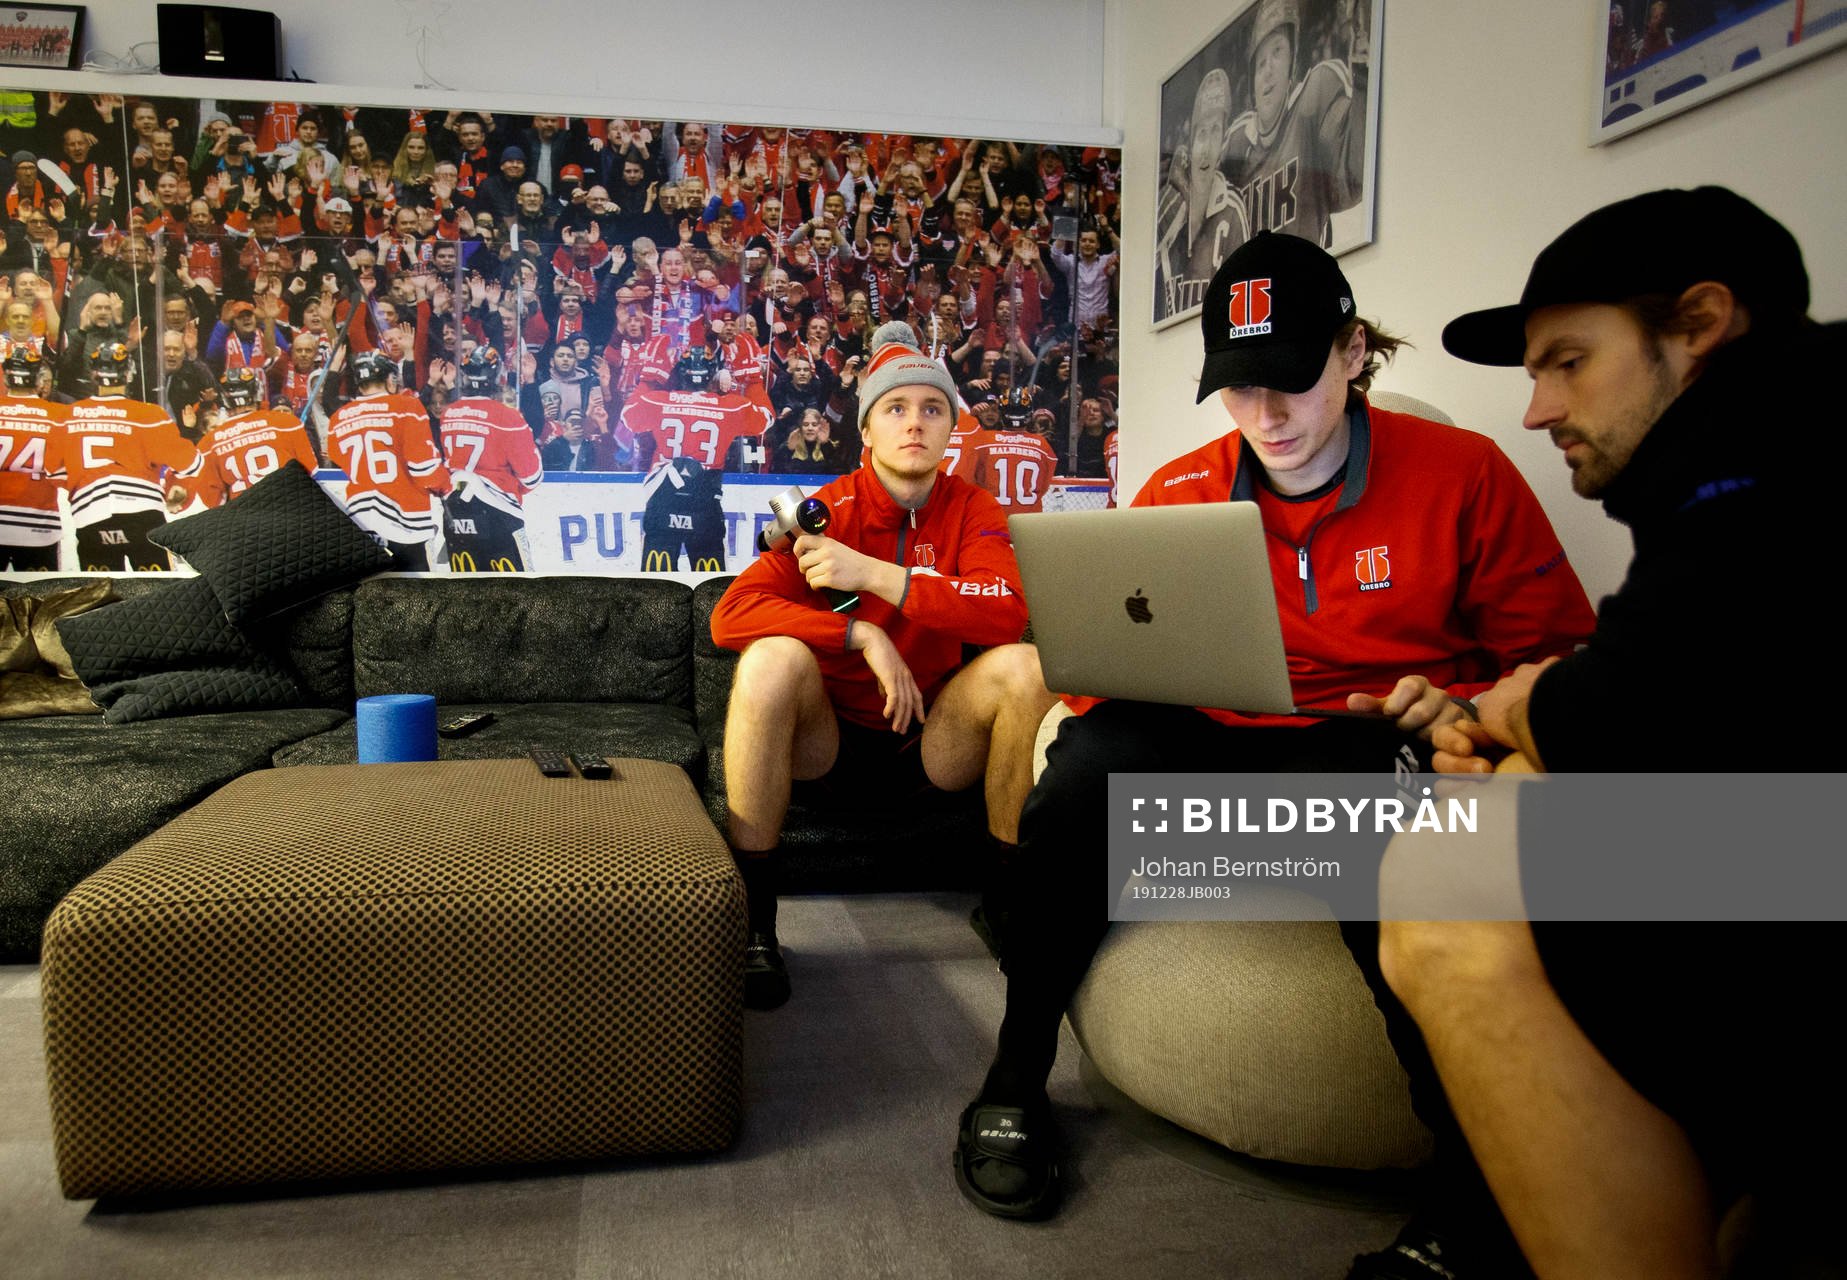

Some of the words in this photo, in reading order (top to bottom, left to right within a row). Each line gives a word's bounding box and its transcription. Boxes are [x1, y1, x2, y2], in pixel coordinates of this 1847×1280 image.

[1231, 325, 1270, 337] ÖREBRO
[661, 418, 719, 464] 33
[0, 435, 46, 479] 74
[338, 431, 398, 484] 76
[995, 459, 1040, 506] 10
[453, 519, 478, 534] NA
[669, 514, 694, 530] NA
[98, 530, 130, 545] NA
[1360, 581, 1390, 591] ÖREBRO
